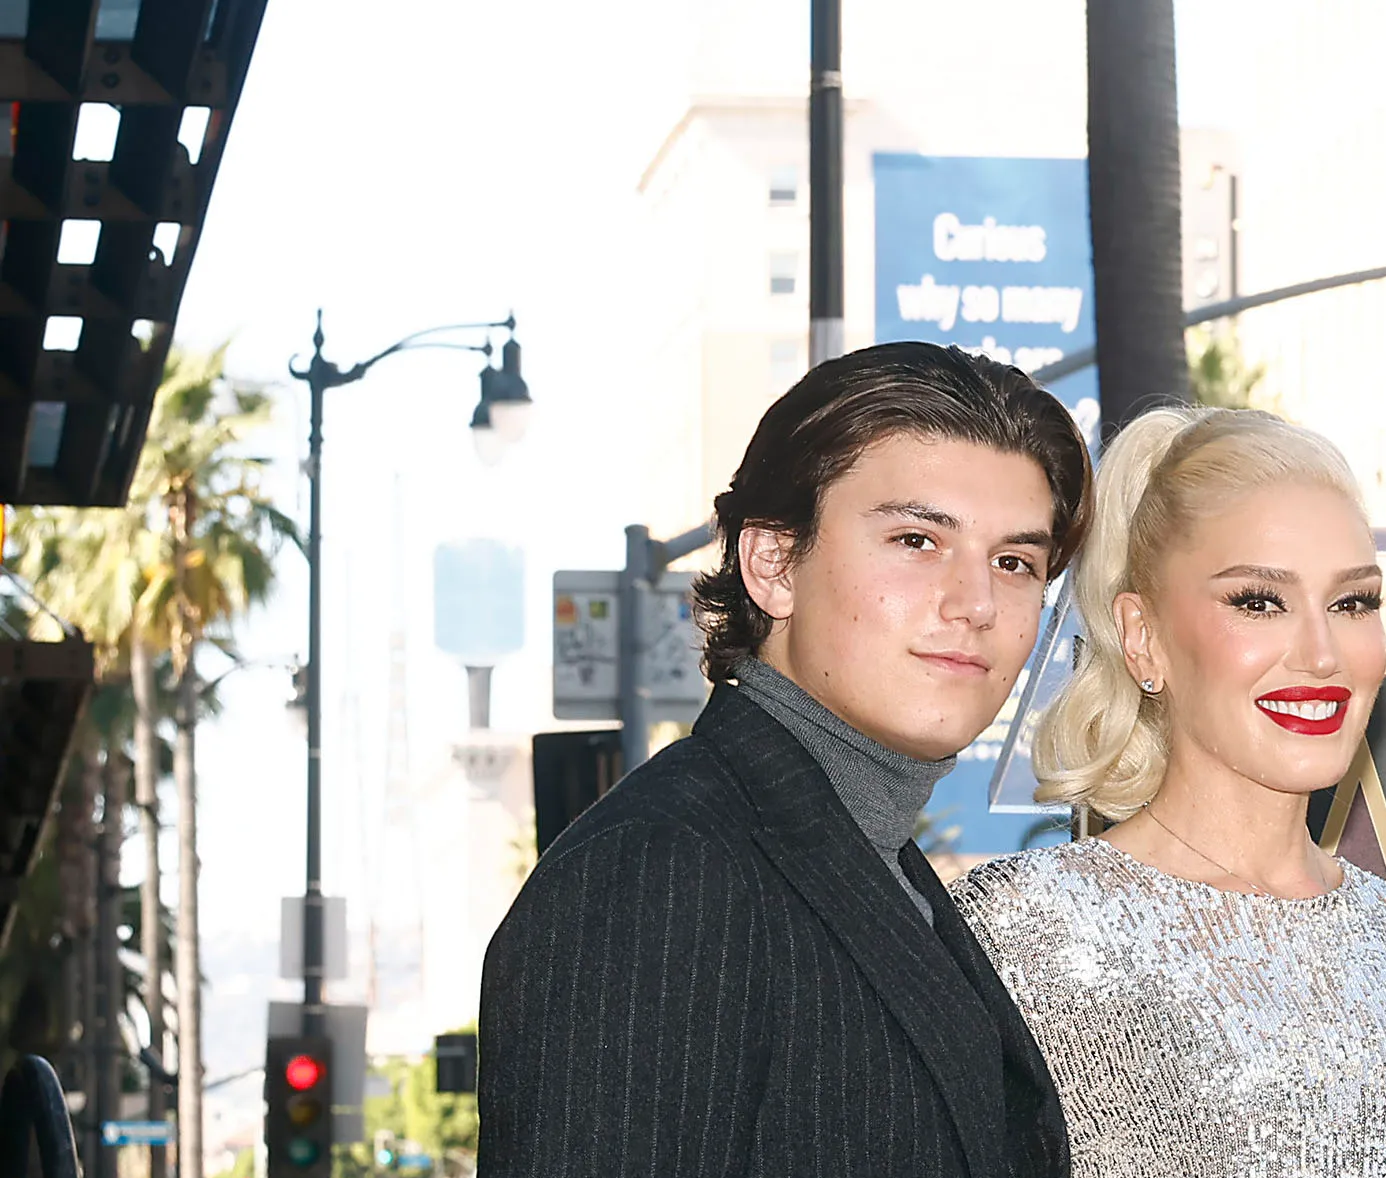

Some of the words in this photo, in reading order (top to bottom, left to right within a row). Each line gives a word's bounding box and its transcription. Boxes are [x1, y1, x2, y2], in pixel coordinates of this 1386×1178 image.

[933, 212, 1047, 262] Curious
[896, 273, 960, 332] why
[961, 285, 999, 322] so
[1001, 285, 1083, 333] many
